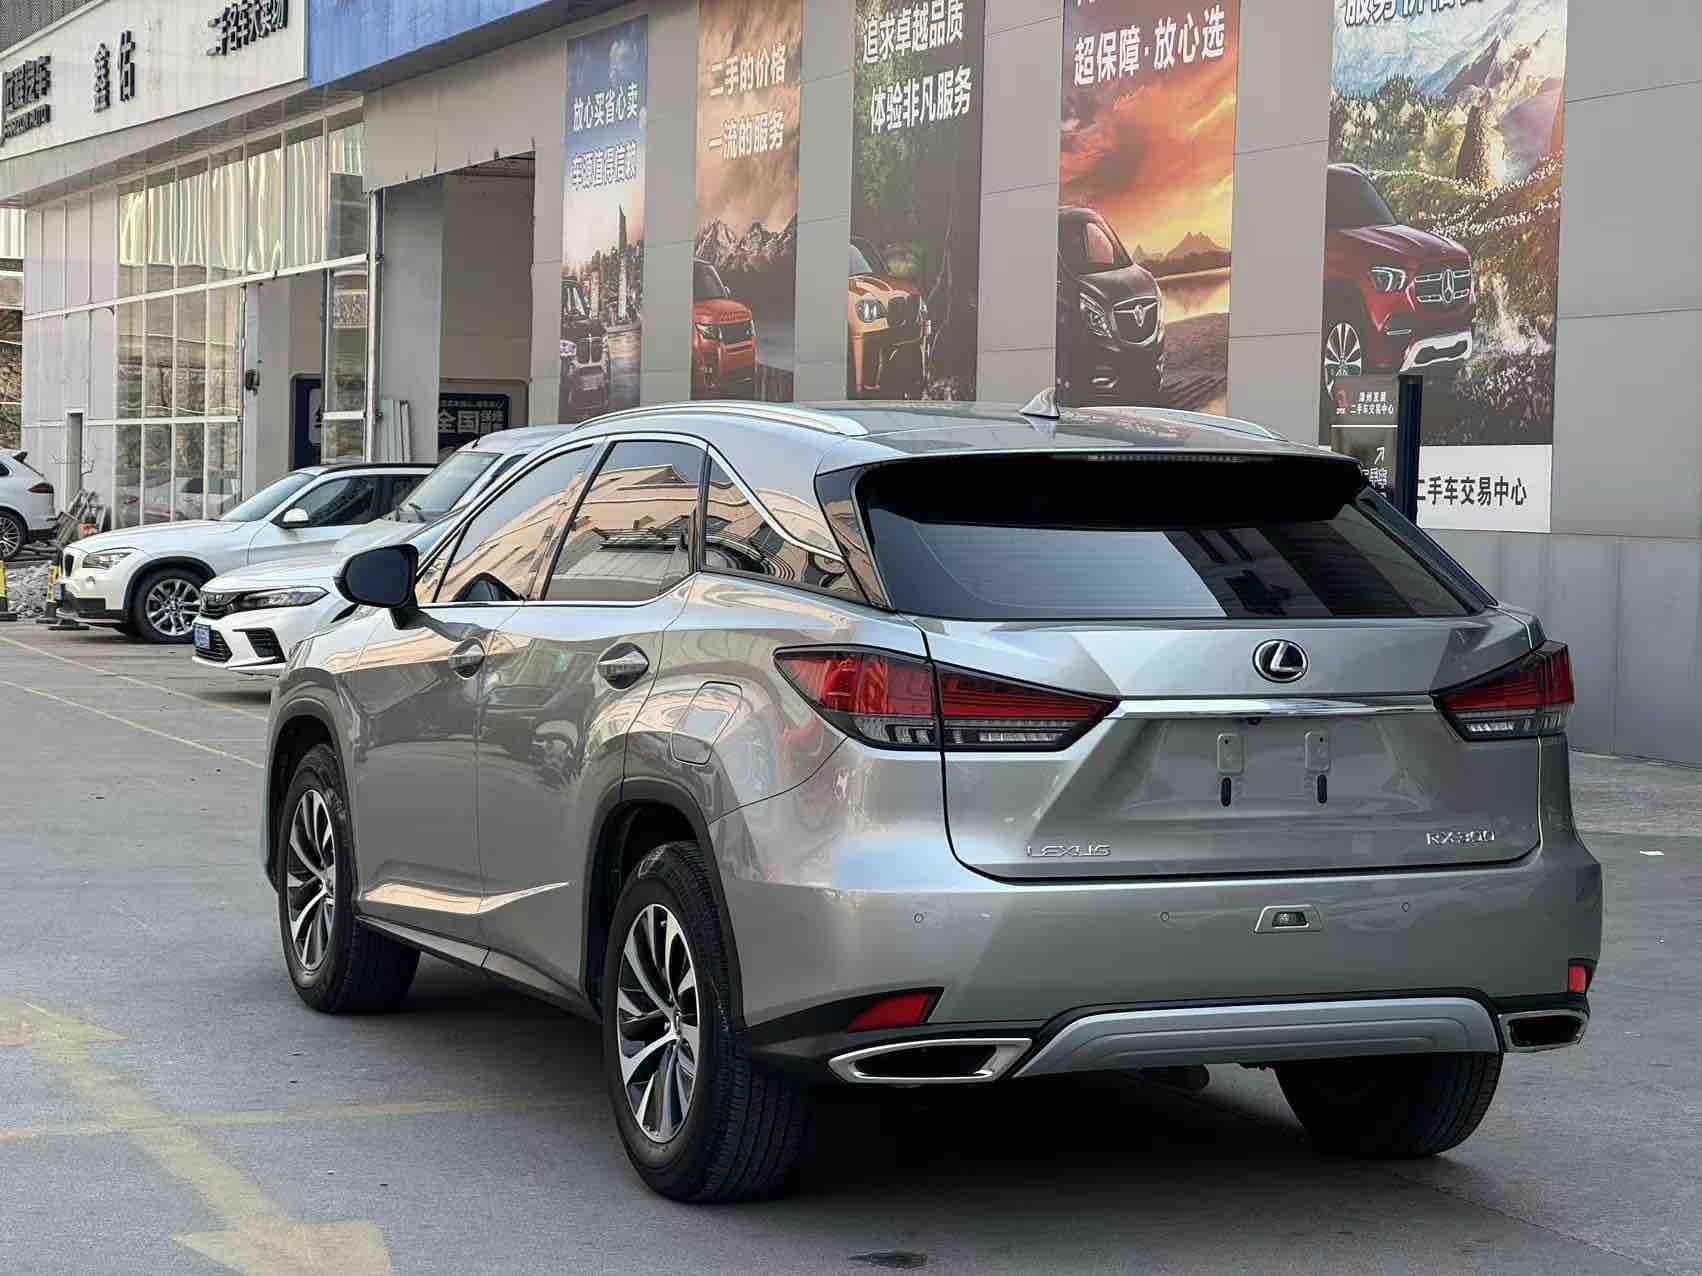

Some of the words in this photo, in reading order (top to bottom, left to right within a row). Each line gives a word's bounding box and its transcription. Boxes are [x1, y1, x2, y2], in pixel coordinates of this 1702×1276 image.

[862, 0, 963, 64] 追求卓越品质
[1074, 4, 1225, 87] 超保障·放心选
[710, 42, 786, 97] 二手的价格
[573, 82, 640, 131] 放心买省心卖
[871, 65, 972, 134] 体验非凡服务
[708, 110, 785, 160] 一流的服务
[1025, 844, 1112, 857] LEXUS
